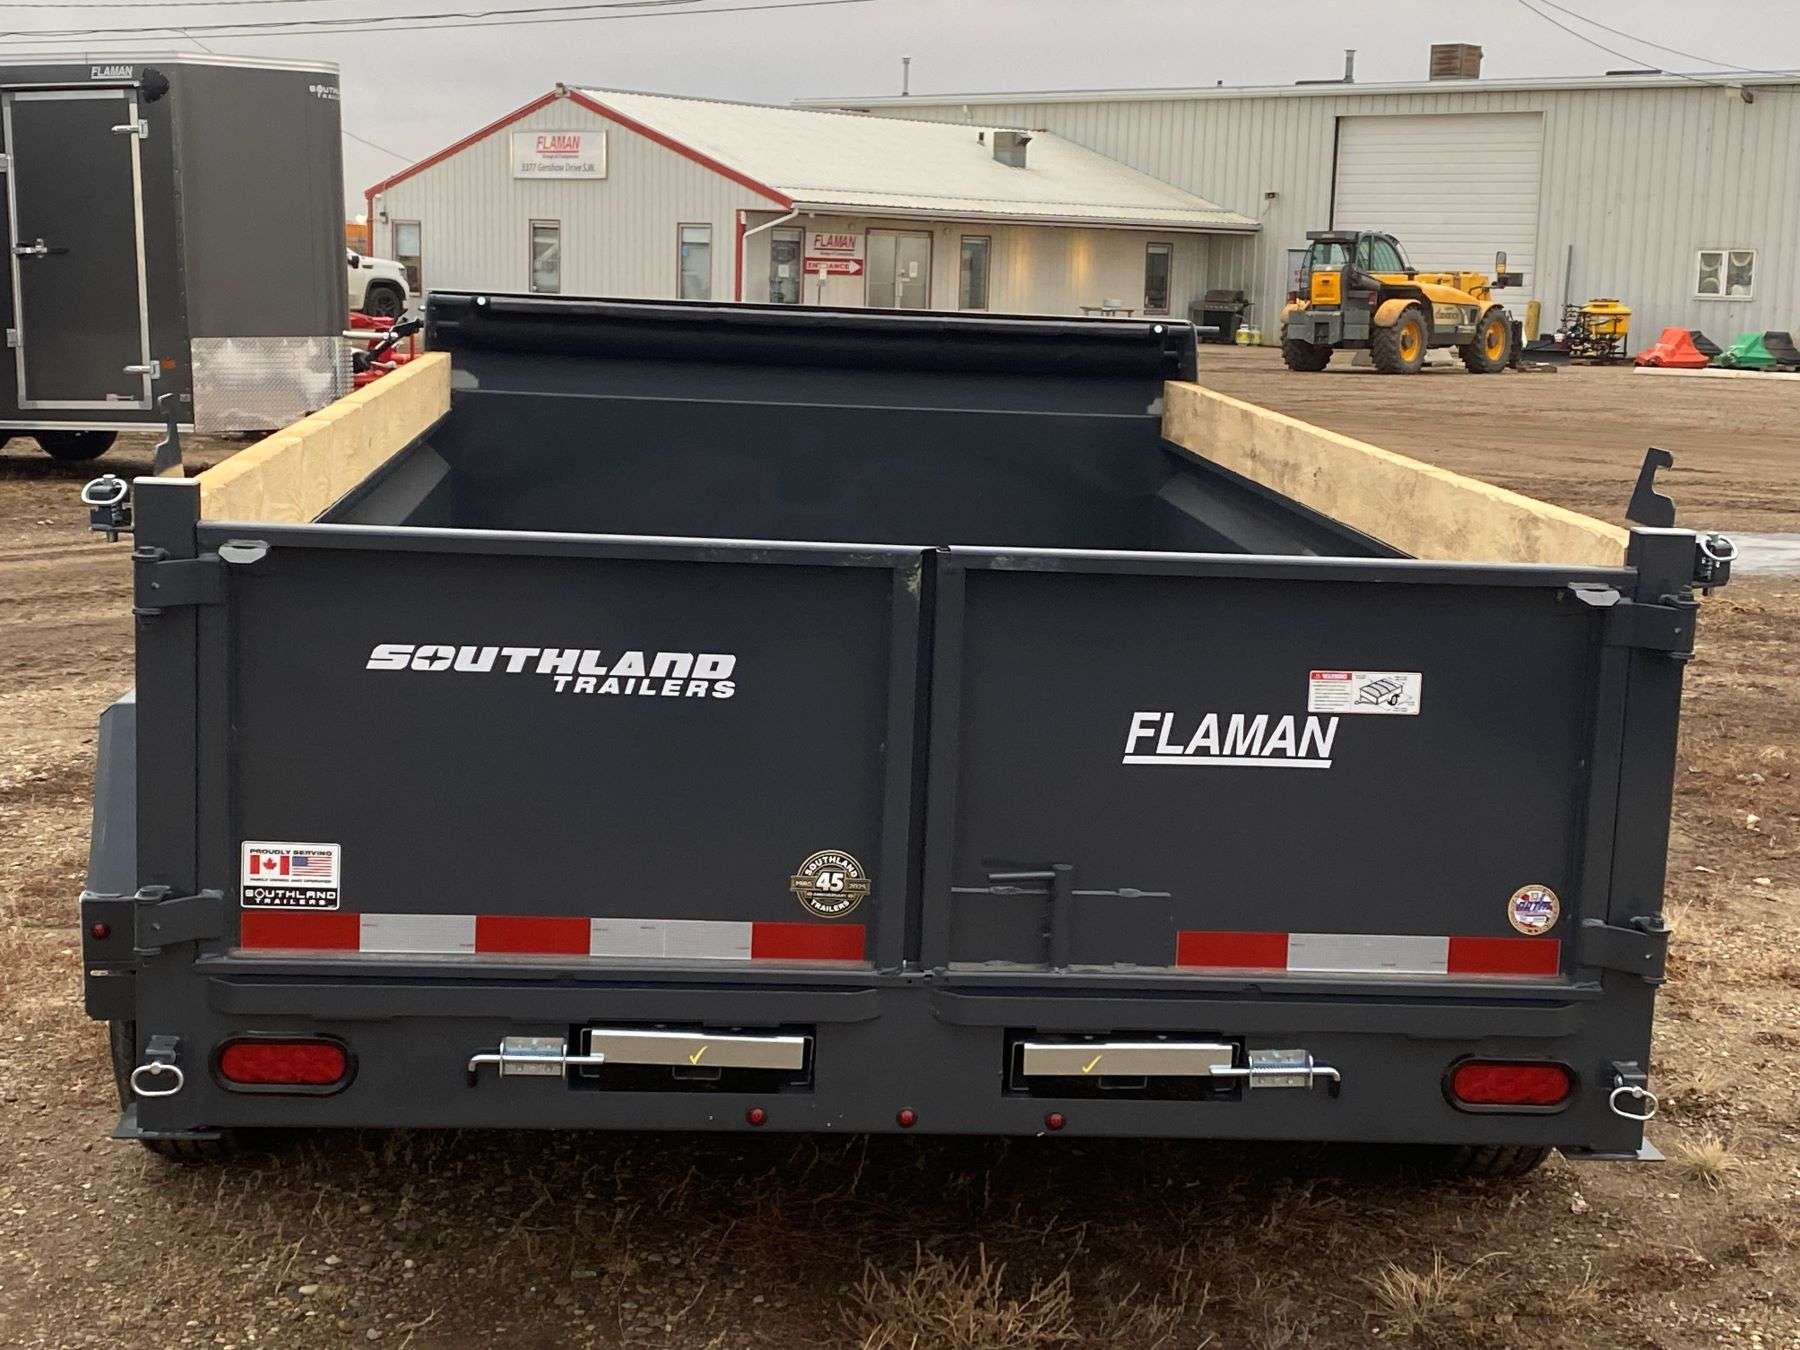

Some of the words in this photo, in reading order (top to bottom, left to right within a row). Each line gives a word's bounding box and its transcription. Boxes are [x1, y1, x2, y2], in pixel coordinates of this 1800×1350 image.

[91, 66, 133, 76] FLAMAN
[536, 135, 580, 150] FLAMAN
[815, 234, 856, 249] FLAMAN
[366, 644, 737, 680] SOUTHLAND
[553, 675, 736, 698] TRAILERS
[1124, 711, 1339, 758] FLAMAN
[805, 856, 858, 878] SOUTHLAND
[816, 872, 844, 892] 45
[245, 887, 336, 899] SOUTHLAND
[810, 899, 850, 912] TRAILERS
